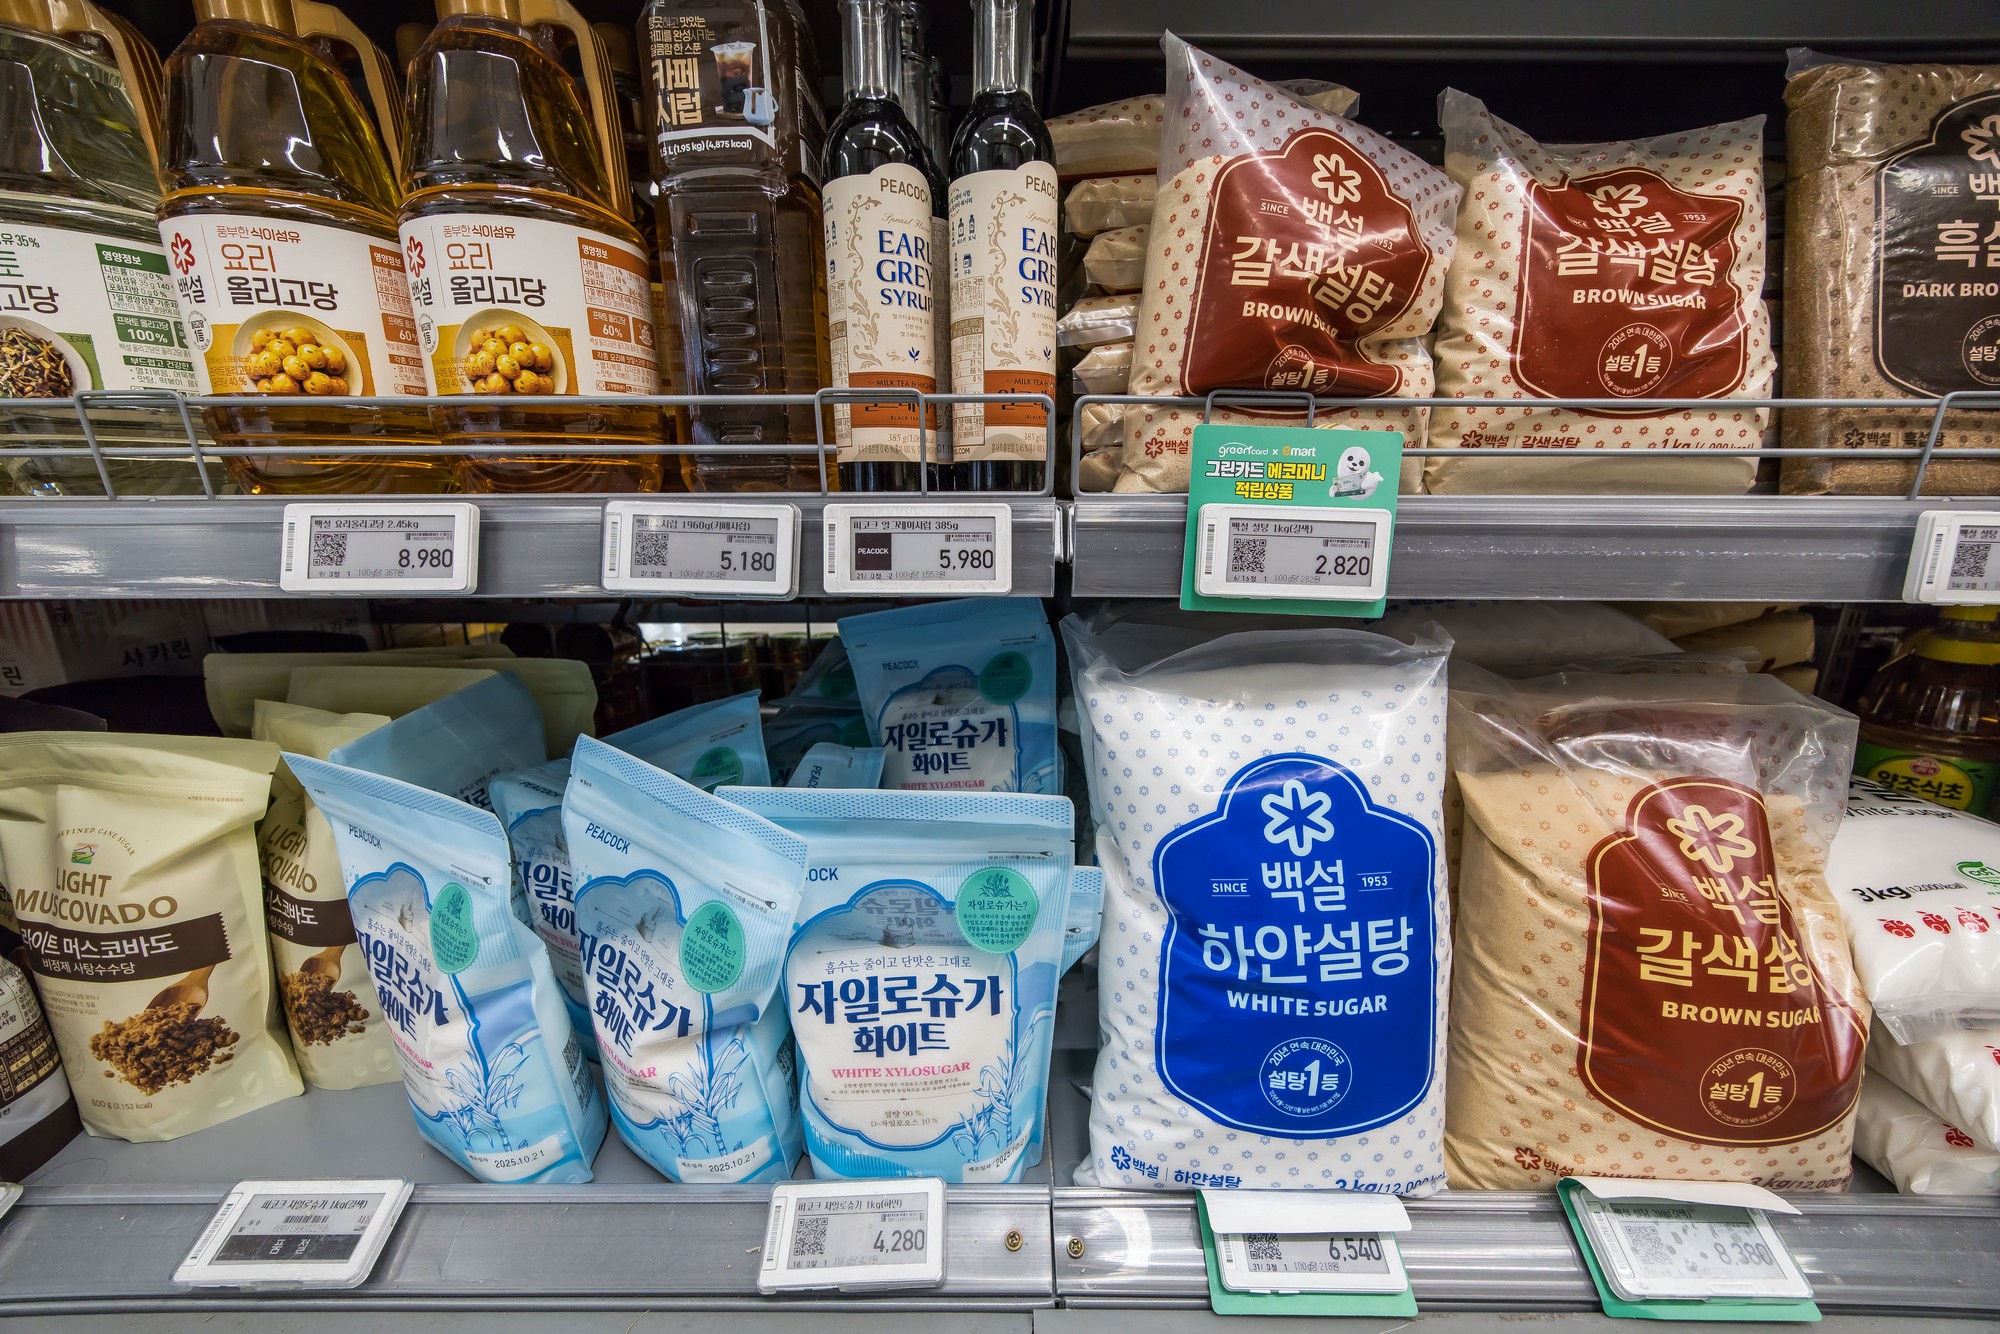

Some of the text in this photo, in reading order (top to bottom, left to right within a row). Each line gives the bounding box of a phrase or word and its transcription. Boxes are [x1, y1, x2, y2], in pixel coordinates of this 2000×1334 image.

[680, 16, 706, 28] 맛있는
[673, 29, 716, 42] 완성시키는
[673, 43, 702, 55] 한 스푼
[651, 58, 700, 90] 카페
[657, 92, 703, 126] 시럽
[705, 139, 729, 149] (4,875
[730, 138, 752, 149] kcal)
[1931, 186, 1959, 195] SINCE
[1260, 202, 1289, 215] SINCE
[1683, 213, 1706, 222] 1953
[216, 225, 302, 244] 풍부한 식이섬유
[443, 224, 516, 240] 풍부한 식이섬유
[1301, 197, 1364, 253] 백설
[1594, 211, 1675, 237] 백설
[15, 234, 40, 248] 35%
[582, 244, 608, 259] 영양정보
[878, 230, 932, 265] EARL
[101, 250, 142, 266] 영양정보
[221, 243, 276, 273] 요리
[373, 252, 402, 267] 영양정보
[447, 242, 493, 270] 요리
[1556, 231, 1719, 287] 갈색설탕
[876, 259, 932, 292] GREY
[1231, 236, 1394, 325] 갈색설탕
[178, 274, 206, 305] 백설
[227, 275, 339, 311] 올리고당
[411, 277, 433, 307] 백설
[450, 275, 547, 307] 올리고당
[880, 287, 933, 313] SYRUP
[1573, 288, 1707, 310] BROWN SUGAR
[1903, 283, 1955, 299] DARK
[1242, 301, 1313, 327] BROWN
[127, 328, 168, 344] 100%
[602, 324, 623, 338] 60%
[1608, 326, 1668, 351] 20년 연속 대한민국
[1969, 324, 1986, 341] 20년
[130, 357, 190, 370] 부드럽고 건강한
[887, 433, 901, 441] 385
[1165, 439, 1189, 455] 백설
[1484, 434, 1509, 448] 백설
[1867, 431, 1891, 447] 백설
[1219, 442, 1316, 457] greencard emart
[1205, 460, 1327, 480] 그린카드 에코머니
[1235, 482, 1294, 500] 적립상품
[335, 519, 384, 529] 요리올리고당
[387, 520, 419, 530] 2.45kg
[853, 521, 959, 531] 피코크 385g
[1252, 522, 1313, 534] 설탕 1kg(갈색)
[398, 548, 453, 569] 8,980
[720, 551, 775, 571] 5,180
[857, 547, 889, 555] PEACOCK
[939, 549, 993, 570] 5,980
[1315, 554, 1370, 576] 2,820
[123, 637, 192, 668] 사카린
[882, 659, 919, 671] PEACOCK
[884, 717, 1007, 752] 자일로슈가
[912, 752, 971, 775] 화이트
[901, 779, 985, 790] WHITE XYLOSUGAR
[97, 828, 135, 857] CANE SUGAR
[348, 823, 383, 851] PEACOCK
[585, 822, 631, 854] PEACOCK
[56, 867, 112, 897] LIGHT
[1212, 874, 1388, 894] SINCE 1953
[1261, 859, 1346, 913] 백설
[15, 888, 178, 925] MUSCOVADO
[967, 899, 1028, 912] 자일로슈가는?
[1693, 874, 1780, 926] 백설
[21, 928, 179, 960] 라이트 머스코바도
[694, 925, 737, 960] 자일로슈가는?
[1197, 915, 1414, 985] 하얀설탕
[596, 920, 619, 942] 흡수는
[620, 933, 641, 956] 줄이고
[640, 949, 656, 974] 단맛은
[653, 965, 676, 990] 그대로
[824, 955, 972, 975] 흡수는 줄이고 단맛은 그대로
[42, 958, 136, 976] 비정제 사탕수수당
[354, 927, 450, 1027] 자일로슈가
[578, 927, 694, 1039] 자일로슈가
[796, 973, 1004, 1024] 자일로슈가
[1226, 990, 1387, 1018] WHITE SUGAR
[377, 983, 418, 1042] 화이트
[593, 989, 637, 1058] 화이트
[1661, 1000, 1761, 1027] BROWN
[853, 1022, 950, 1058] 화이트
[1269, 1041, 1345, 1067] 20년 연속 대한민국
[831, 1061, 971, 1079] WHITE XYLOSUGAR
[1711, 1052, 1791, 1079] 20년 연속 대한민국
[91, 1098, 107, 1109] 800
[135, 1101, 153, 1111] kcal)
[884, 1110, 900, 1119] 설탕
[870, 1118, 919, 1128] D-자일로오스
[494, 1150, 545, 1169] 2025.10.21
[708, 1151, 756, 1173] 2025.10.21
[1543, 1159, 1575, 1178] 백설
[1132, 1156, 1242, 1189] 백설 하얀설탕
[288, 1200, 328, 1210] 자일로슈가
[329, 1199, 368, 1210] 1kg(갈색)
[798, 1198, 903, 1212] 피코크 자일로슈가 1kg(하얀)
[873, 1229, 925, 1254] 4,280
[1328, 1237, 1383, 1261] 6,540
